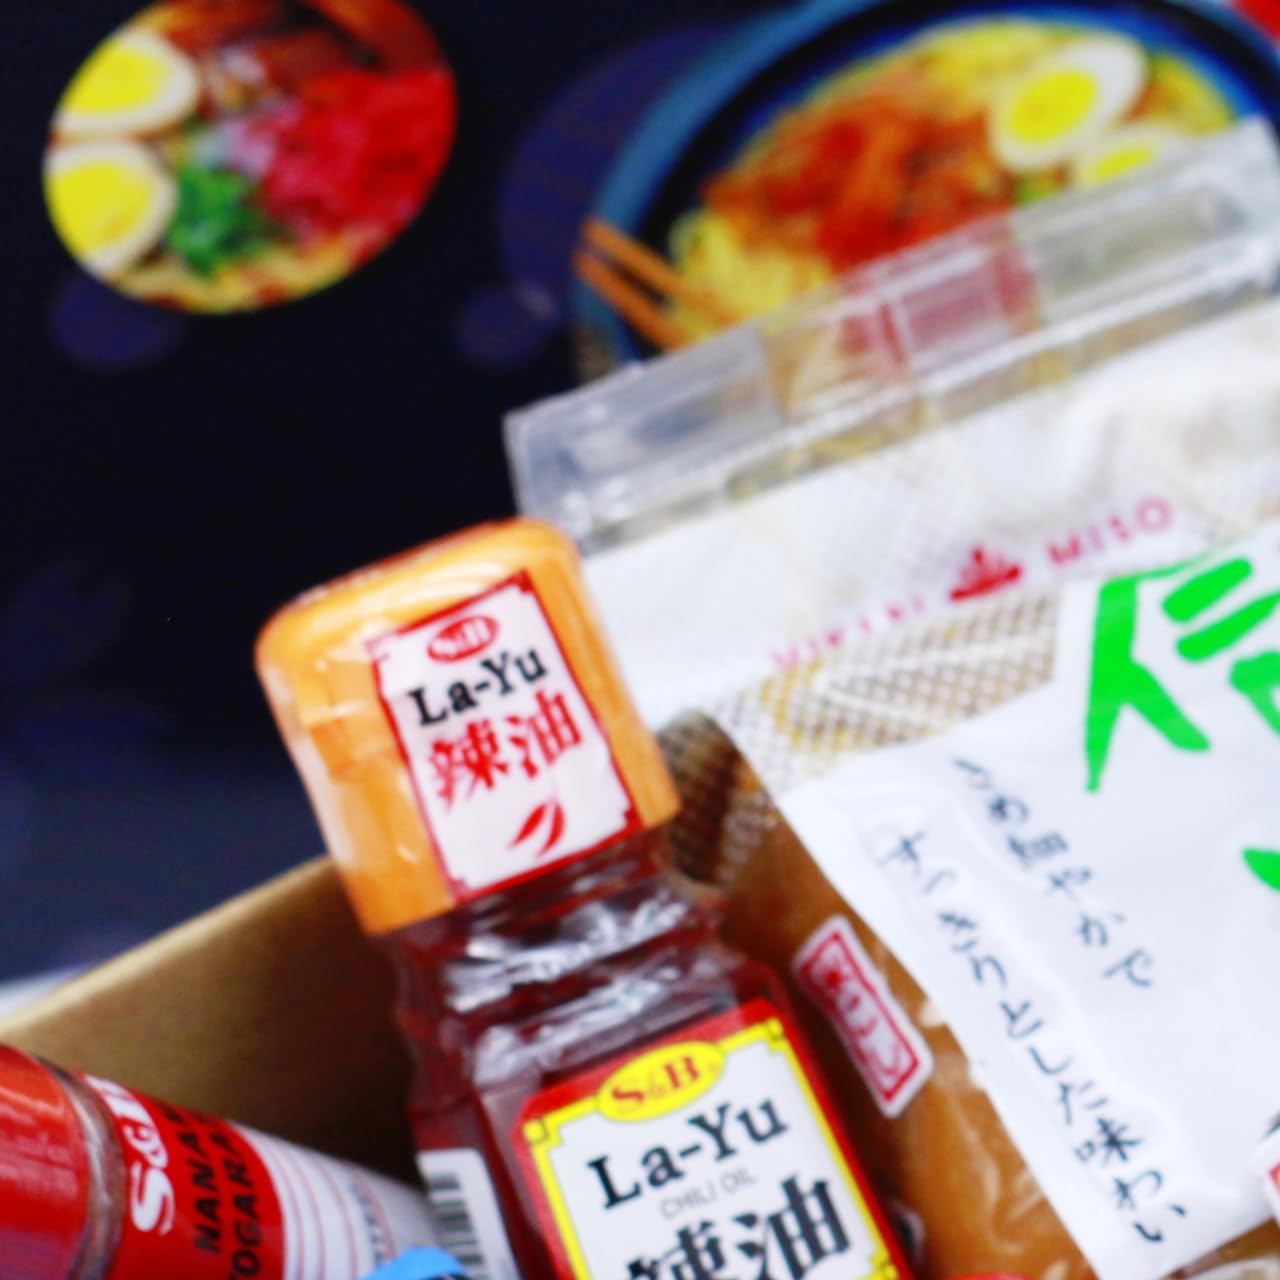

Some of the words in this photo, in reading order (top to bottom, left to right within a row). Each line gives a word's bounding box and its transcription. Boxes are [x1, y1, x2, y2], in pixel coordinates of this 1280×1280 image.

[408, 648, 548, 726] La-Yu
[427, 689, 584, 809] 辣油
[587, 1098, 789, 1210] La-Yu
